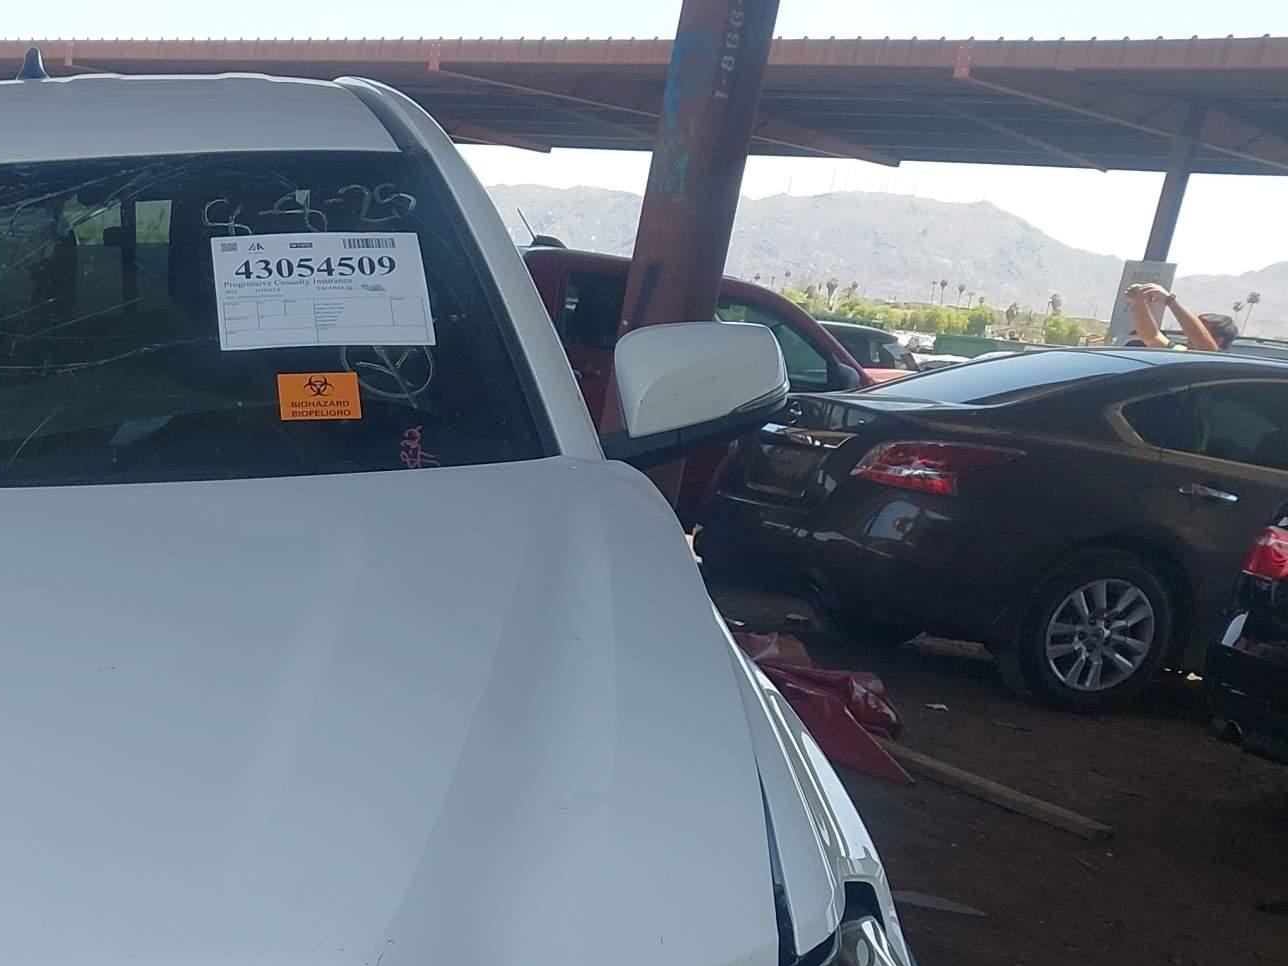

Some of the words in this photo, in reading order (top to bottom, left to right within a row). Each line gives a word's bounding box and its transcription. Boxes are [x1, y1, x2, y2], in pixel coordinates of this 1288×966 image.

[234, 256, 397, 280] 43054509
[224, 280, 272, 289] Progressive
[274, 279, 310, 287] Casualty
[291, 400, 351, 408] BIOHAZARD
[292, 409, 352, 417] BIOPELIGRO
